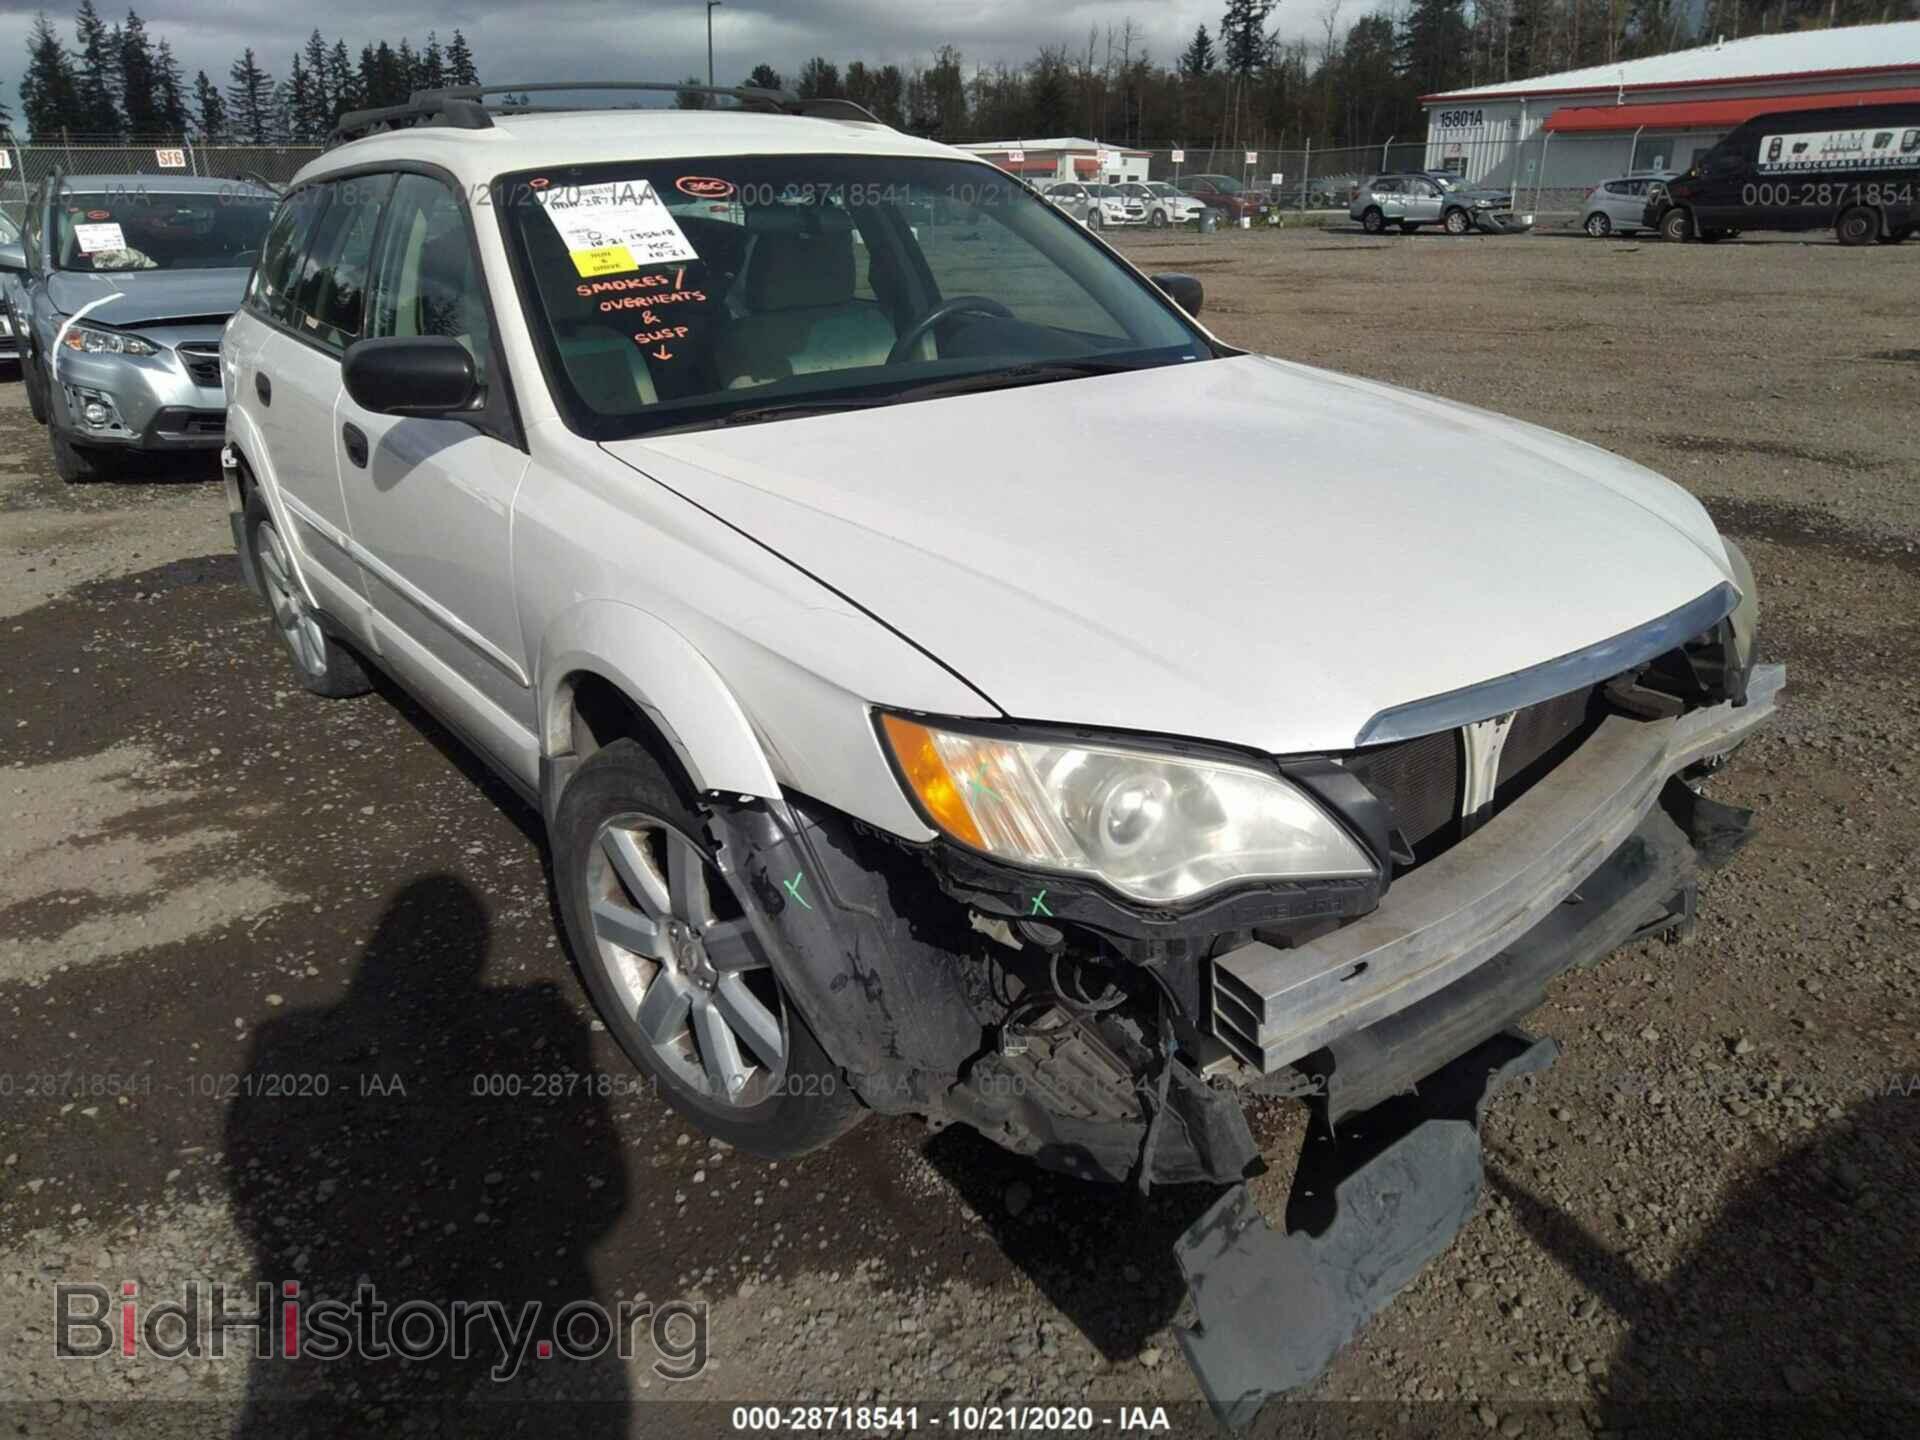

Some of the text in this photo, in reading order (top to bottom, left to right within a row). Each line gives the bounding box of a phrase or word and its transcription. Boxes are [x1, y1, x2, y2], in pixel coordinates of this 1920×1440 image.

[1440, 110, 1483, 127] 15801A
[160, 151, 184, 165] SF6
[600, 290, 707, 312] OVERHEATS
[641, 310, 661, 325] &
[634, 326, 689, 345] SUSP
